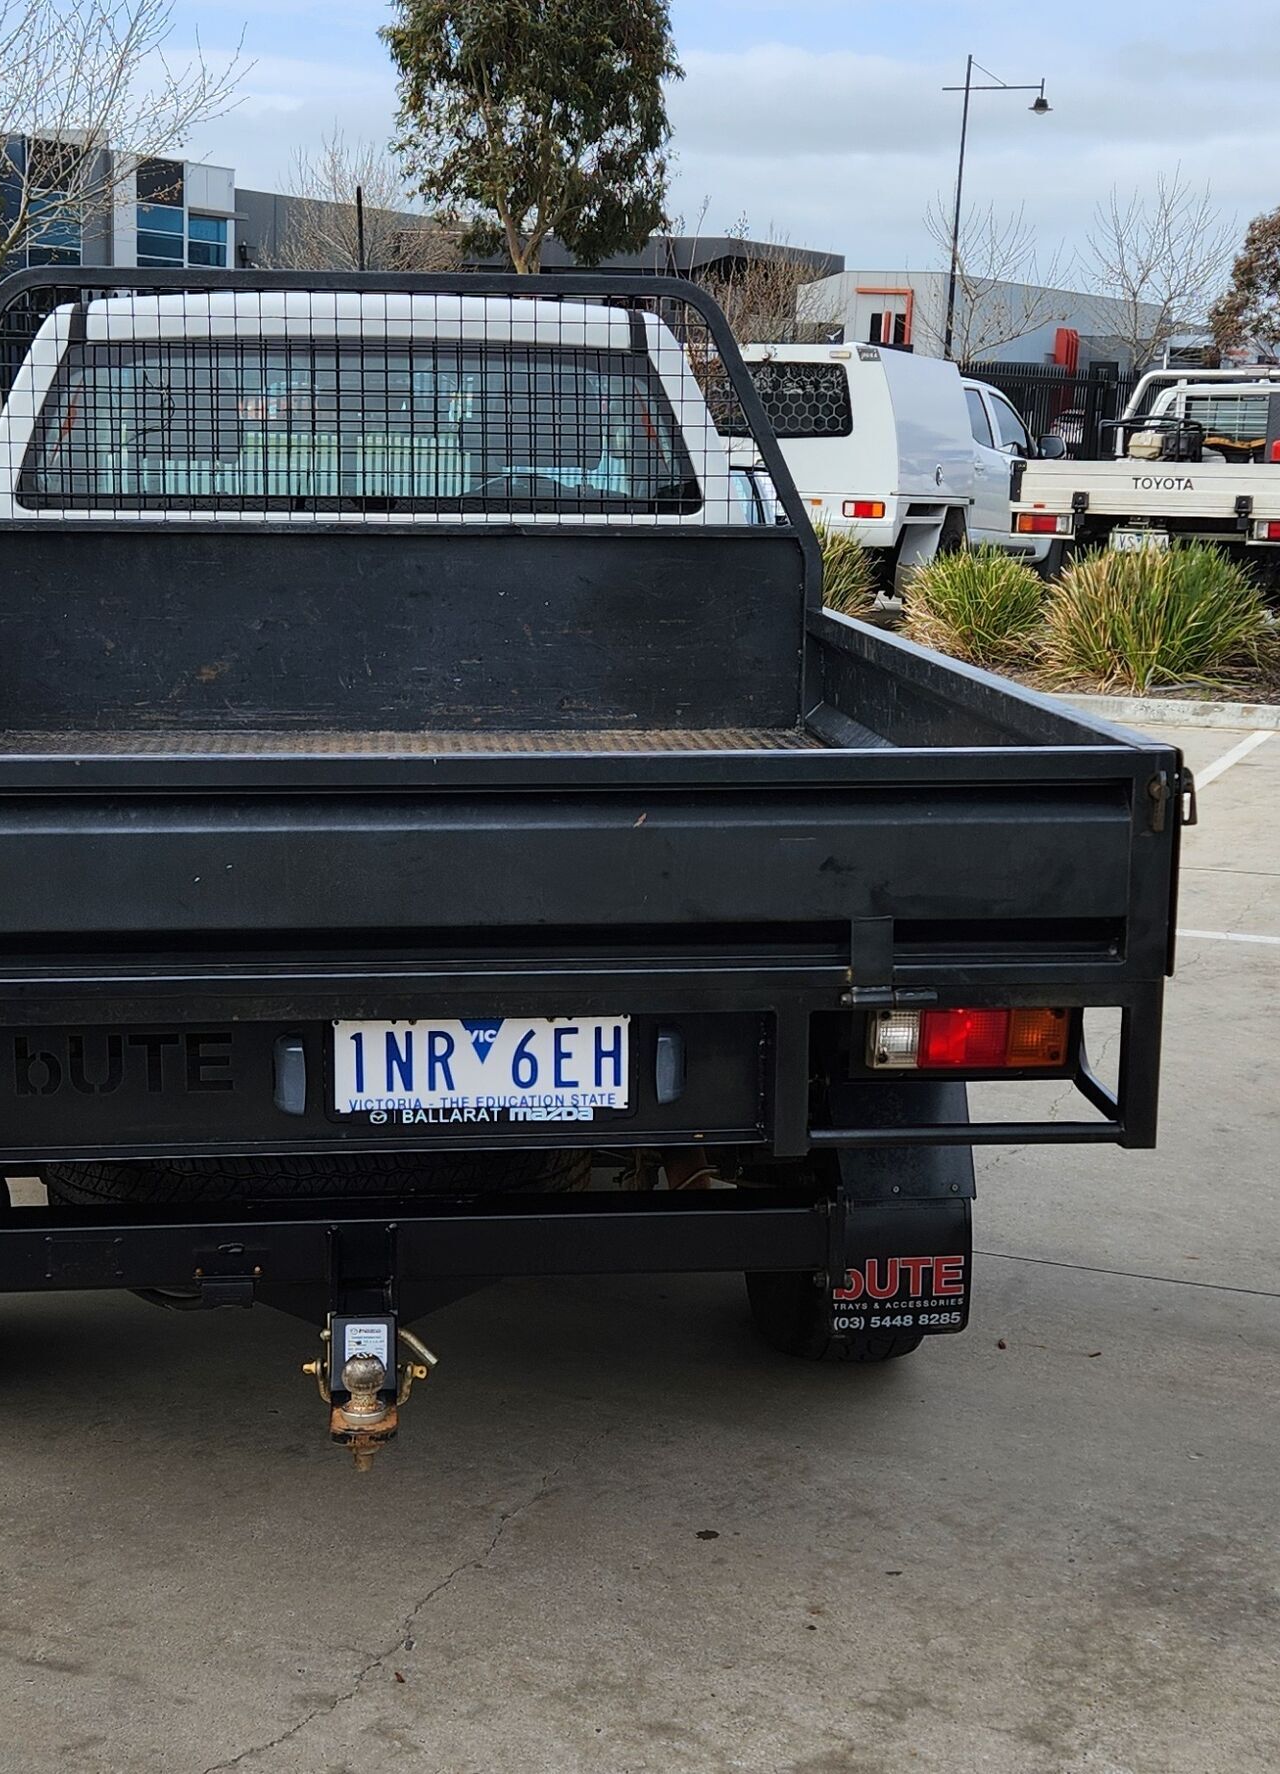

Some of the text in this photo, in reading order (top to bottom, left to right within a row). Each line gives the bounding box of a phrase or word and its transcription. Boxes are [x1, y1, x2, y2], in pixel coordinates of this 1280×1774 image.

[1131, 477, 1194, 491] TOYOTA
[349, 1025, 622, 1094] 1NR 6EH
[348, 1098, 422, 1112] VICTORIA
[440, 1096, 470, 1109] THE
[476, 1094, 565, 1108] EDUCATION
[570, 1093, 616, 1106] STATE
[402, 1108, 502, 1124] BALLARAT
[833, 1298, 964, 1311] TRAYS & ACCESSORIES
[833, 1311, 962, 1331] (03) 5448 8285
